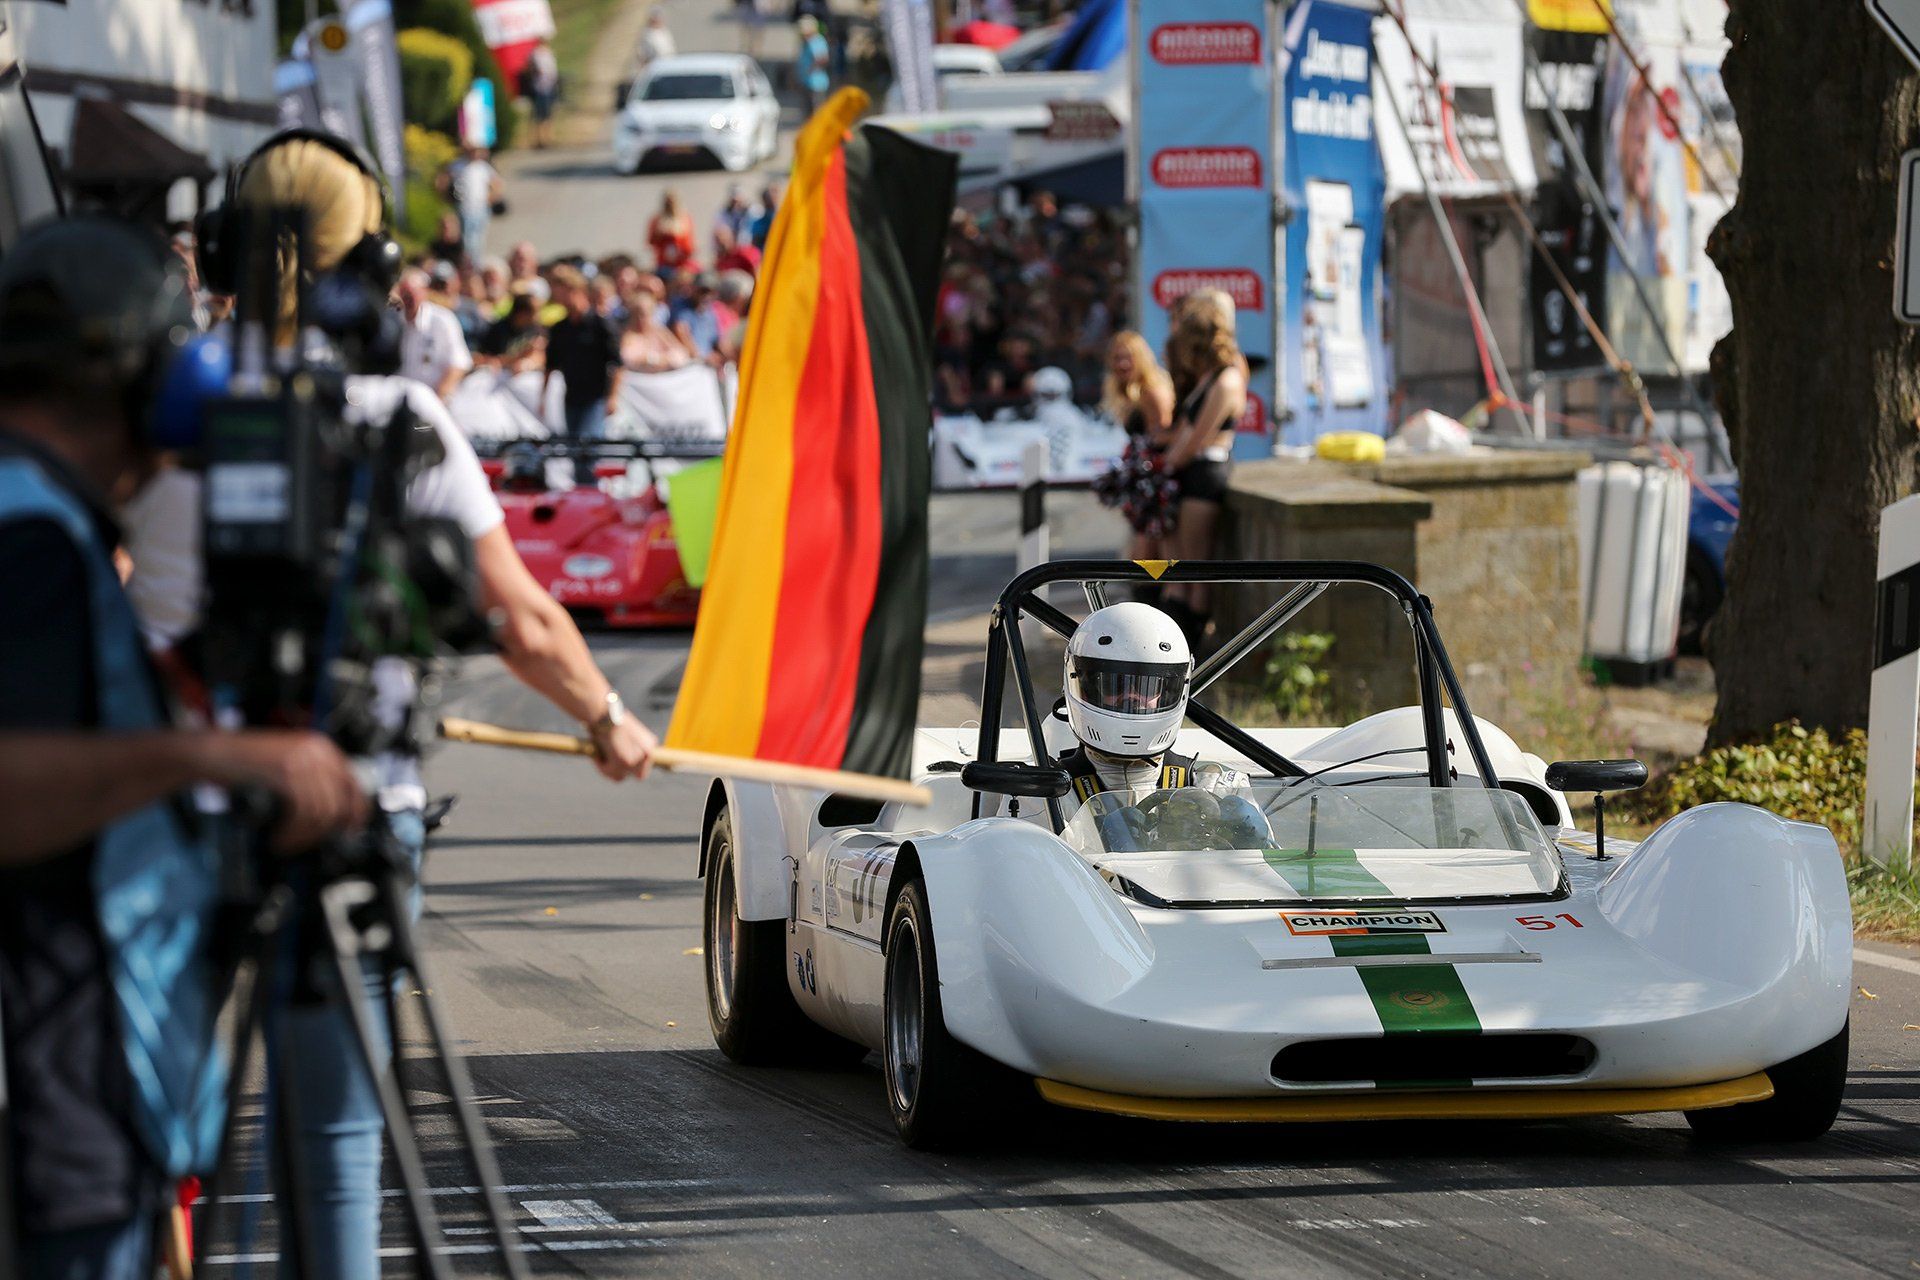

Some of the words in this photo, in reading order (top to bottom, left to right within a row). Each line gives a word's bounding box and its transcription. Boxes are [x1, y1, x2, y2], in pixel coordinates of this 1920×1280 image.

[1157, 26, 1255, 50] antenne
[1158, 150, 1255, 173] antenne
[1291, 916, 1432, 926] CHAMPION
[1515, 913, 1584, 930] 51
